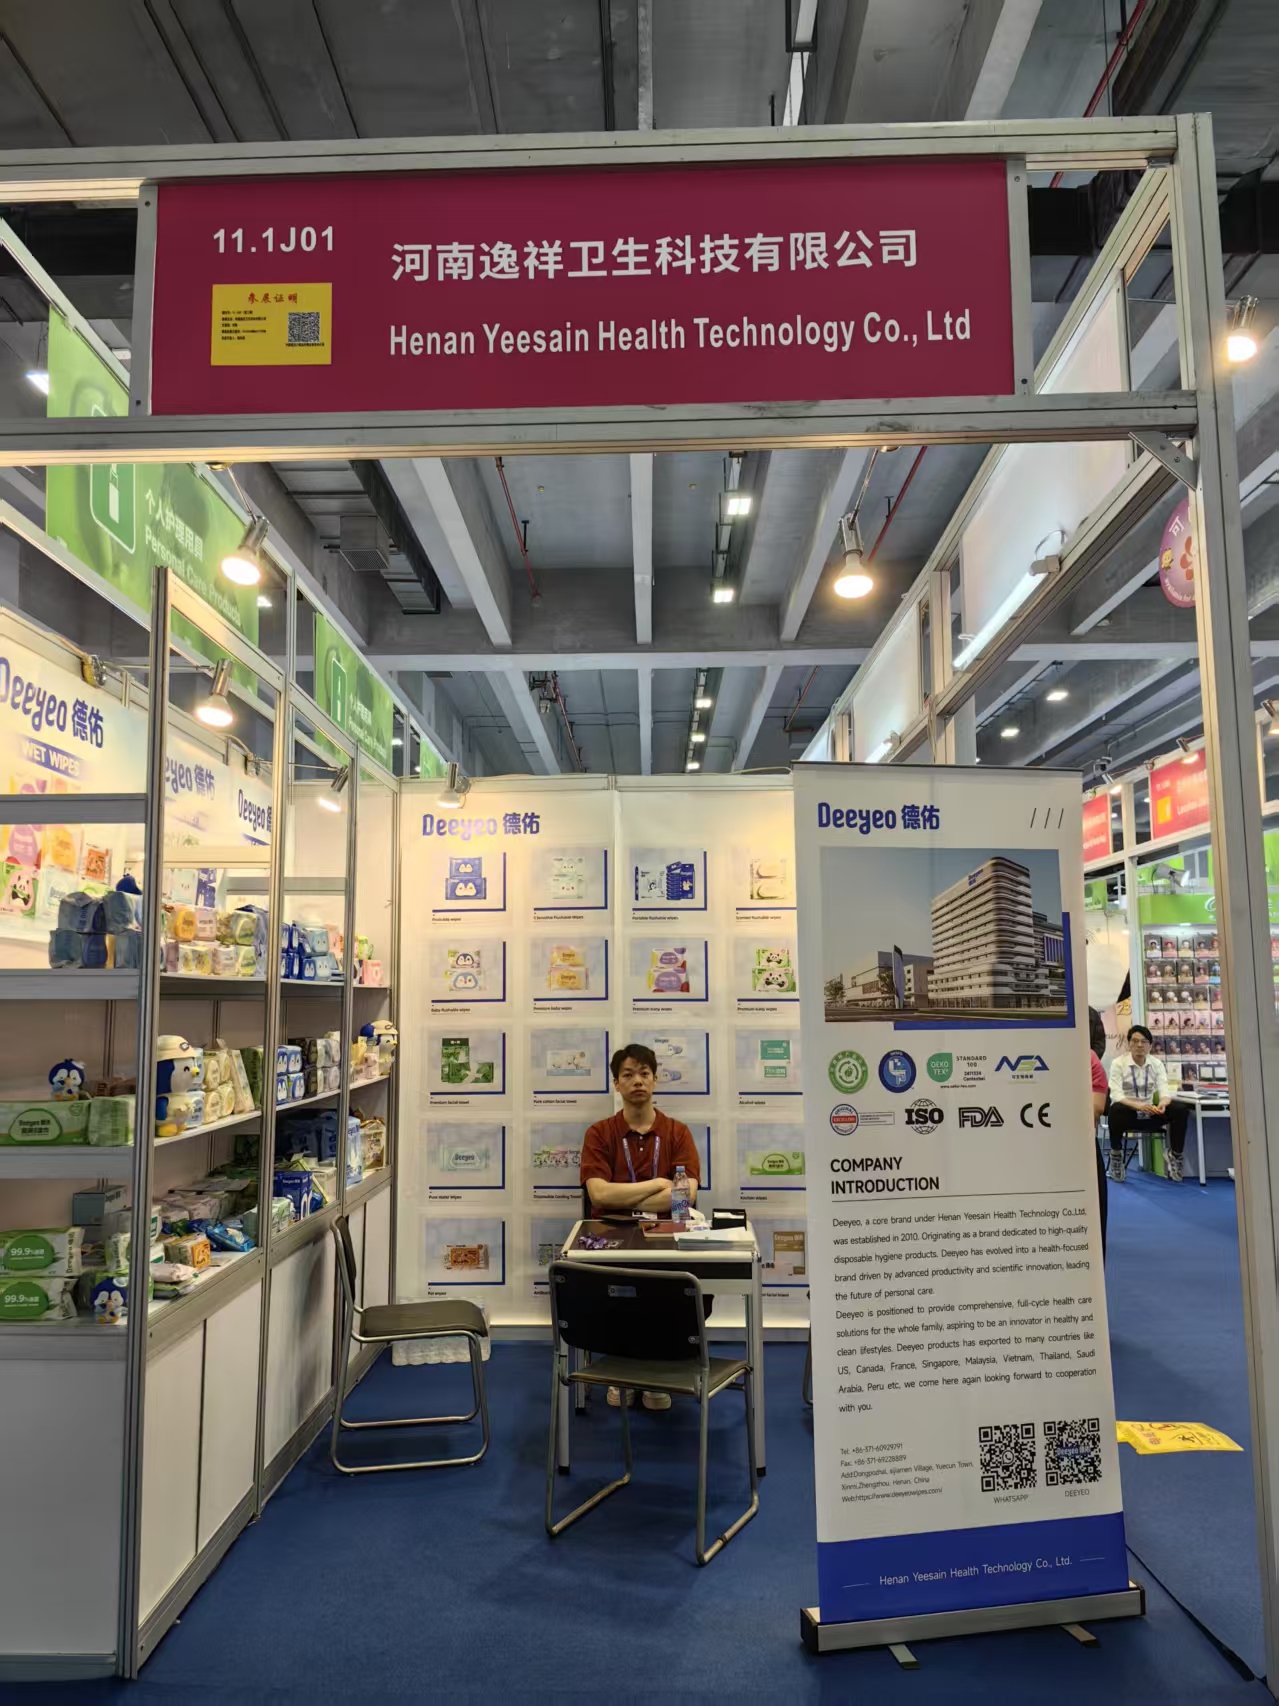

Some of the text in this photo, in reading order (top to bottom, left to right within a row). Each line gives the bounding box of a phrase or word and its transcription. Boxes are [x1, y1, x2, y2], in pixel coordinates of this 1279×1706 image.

[214, 226, 332, 253] 11.1J01
[392, 230, 916, 281] 河南逸祥卫生科技有限公司
[248, 292, 298, 304] 参展证明
[391, 309, 970, 355] Henan Yeesain Health Technology Co., Ltd
[145, 524, 242, 626] Personal Care Products
[72, 698, 104, 748] 德佑
[22, 740, 80, 776] WET WIPES
[238, 788, 265, 832] Deeyeo
[818, 802, 940, 834] Deeyeo 德佑
[422, 812, 540, 840] Deeyeo 德佑
[904, 1108, 944, 1125] ISO
[958, 1106, 1004, 1128] FDA
[1020, 1102, 1051, 1128] CE
[830, 1156, 903, 1172] COMPANY
[831, 1176, 940, 1194] INTRODUCTION
[832, 1218, 862, 1228] Deeyeo,
[890, 1215, 912, 1224] brand
[914, 1213, 936, 1222] under
[938, 1212, 961, 1221] Henan
[964, 1211, 991, 1220] Yeesain
[993, 1210, 1017, 1219] Health
[1019, 1209, 1060, 1219] Technology
[850, 1234, 891, 1244] established
[900, 1232, 919, 1241] 2010.
[921, 1230, 960, 1242] Originating
[978, 1228, 1000, 1237] brand
[1002, 1227, 1037, 1236] dedicated
[1048, 1224, 1088, 1236] high-quality
[834, 1253, 872, 1265] disposable
[874, 1252, 902, 1263] hygiene
[904, 1250, 938, 1261] products.
[941, 1248, 968, 1258] Deeyeo
[986, 1245, 1013, 1255] evolved
[1015, 1245, 1029, 1253] into
[1038, 1242, 1088, 1252] health-focused
[834, 1272, 856, 1282] brand
[858, 1272, 881, 1280] driven
[883, 1271, 892, 1280] by
[894, 1268, 929, 1278] advanced
[931, 1266, 974, 1278] productivity
[976, 1264, 990, 1273] and
[992, 1263, 1023, 1272] scientific
[1066, 1260, 1090, 1270] leading
[835, 1292, 848, 1300] the
[850, 1291, 872, 1299] future
[874, 1288, 882, 1298] of
[884, 1287, 915, 1299] personal
[836, 1310, 864, 1320] Deeyeo
[867, 1308, 873, 1316] is
[876, 1305, 914, 1318] positioned
[916, 1305, 924, 1313] to
[928, 1303, 955, 1314] provide
[1017, 1298, 1050, 1308] full-cycle
[1053, 1296, 1074, 1305] health
[836, 1328, 868, 1337] solutions
[870, 1326, 881, 1335] for
[883, 1326, 895, 1334] the
[897, 1324, 919, 1333] whole
[946, 1320, 974, 1331] aspiring
[1009, 1317, 1042, 1325] innovator
[1044, 1316, 1051, 1324] in
[1053, 1314, 1079, 1324] healthy
[1081, 1313, 1093, 1321] and
[836, 1347, 856, 1356] clean
[896, 1343, 924, 1352] Deeyeo
[927, 1340, 960, 1351] products
[962, 1338, 976, 1346] has
[978, 1336, 1011, 1347] exported
[1025, 1336, 1045, 1344] many
[1048, 1332, 1080, 1342] countries
[837, 1365, 851, 1375] US,
[856, 1364, 885, 1373] Canada,
[922, 1359, 960, 1369] Singapore,
[965, 1355, 997, 1365] Malaysia,
[1076, 1348, 1095, 1358] Saudi
[867, 1382, 884, 1391] Peru
[962, 1376, 981, 1385] again
[984, 1372, 1010, 1383] looking
[1013, 1370, 1041, 1380] forward
[1056, 1368, 1096, 1379] cooperation
[838, 1403, 872, 1412] with you.
[993, 1494, 1029, 1504] WHATSAPP
[1064, 1488, 1090, 1498] DEEYEO
[879, 1555, 1072, 1585] Henan Yeesain Health Technology Co., Ltd.
